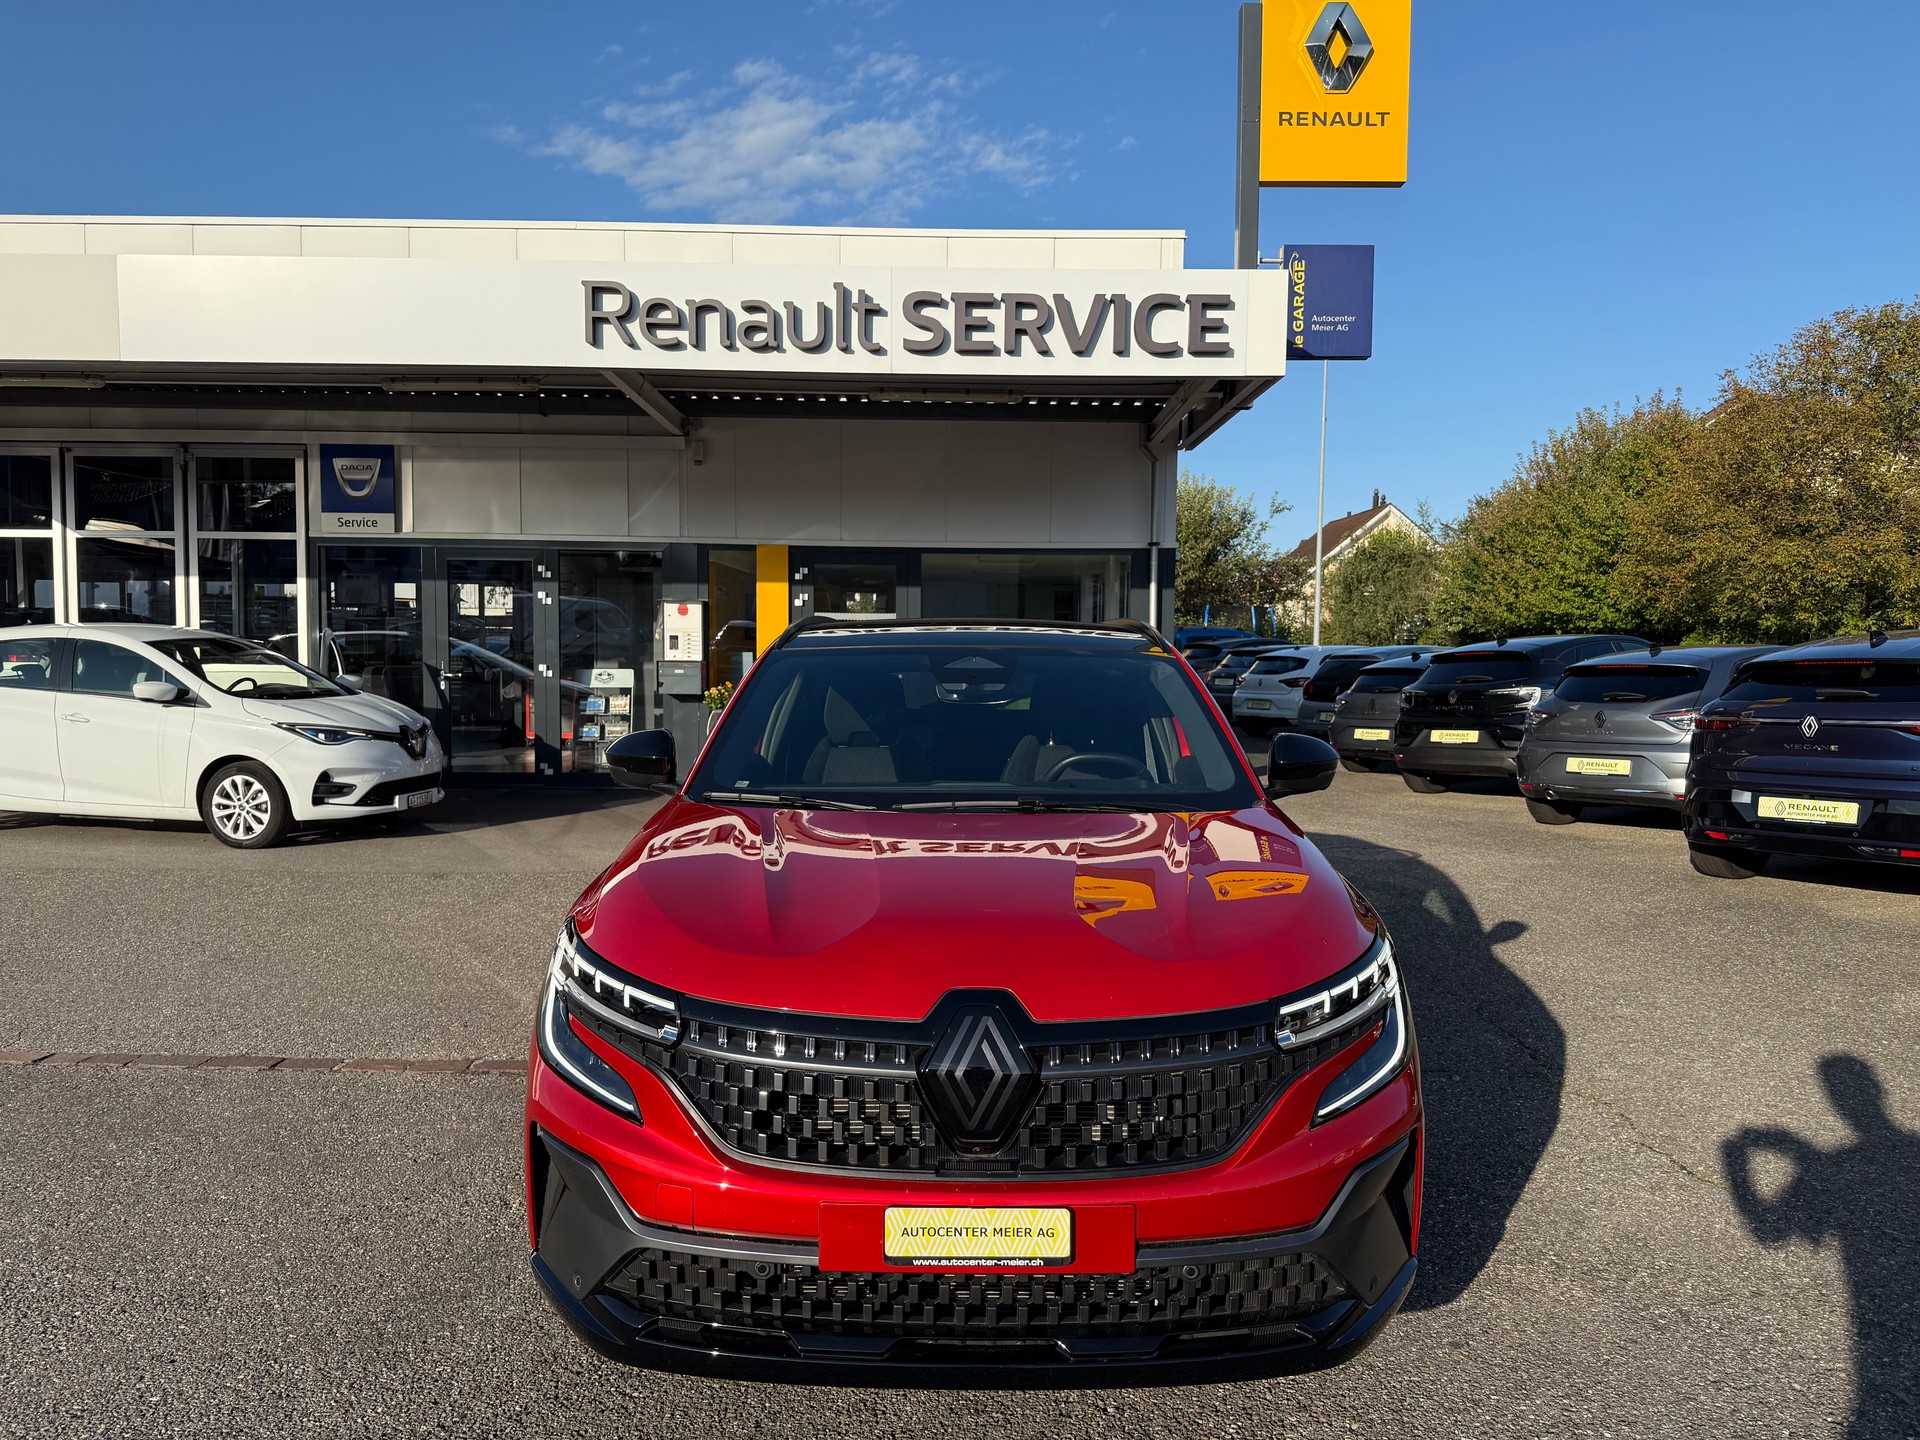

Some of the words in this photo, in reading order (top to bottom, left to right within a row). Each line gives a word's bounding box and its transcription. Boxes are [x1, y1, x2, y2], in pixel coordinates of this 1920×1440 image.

[1278, 111, 1391, 127] RENAULT
[1292, 259, 1306, 332] GARAGE
[581, 280, 888, 357] Renault
[902, 290, 1236, 359] SERVICE
[1311, 314, 1356, 322] Autocenter
[1311, 324, 1334, 332] Meier
[1336, 323, 1349, 331] AG
[1292, 335, 1304, 349] le
[337, 517, 378, 528] Service
[1788, 803, 1838, 813] RENAULT
[901, 1226, 988, 1237] AUTOCENTER
[993, 1227, 1033, 1238] MEIER
[1037, 1228, 1055, 1238] AG
[912, 1257, 1044, 1266] www.autocenter-meier.ch
